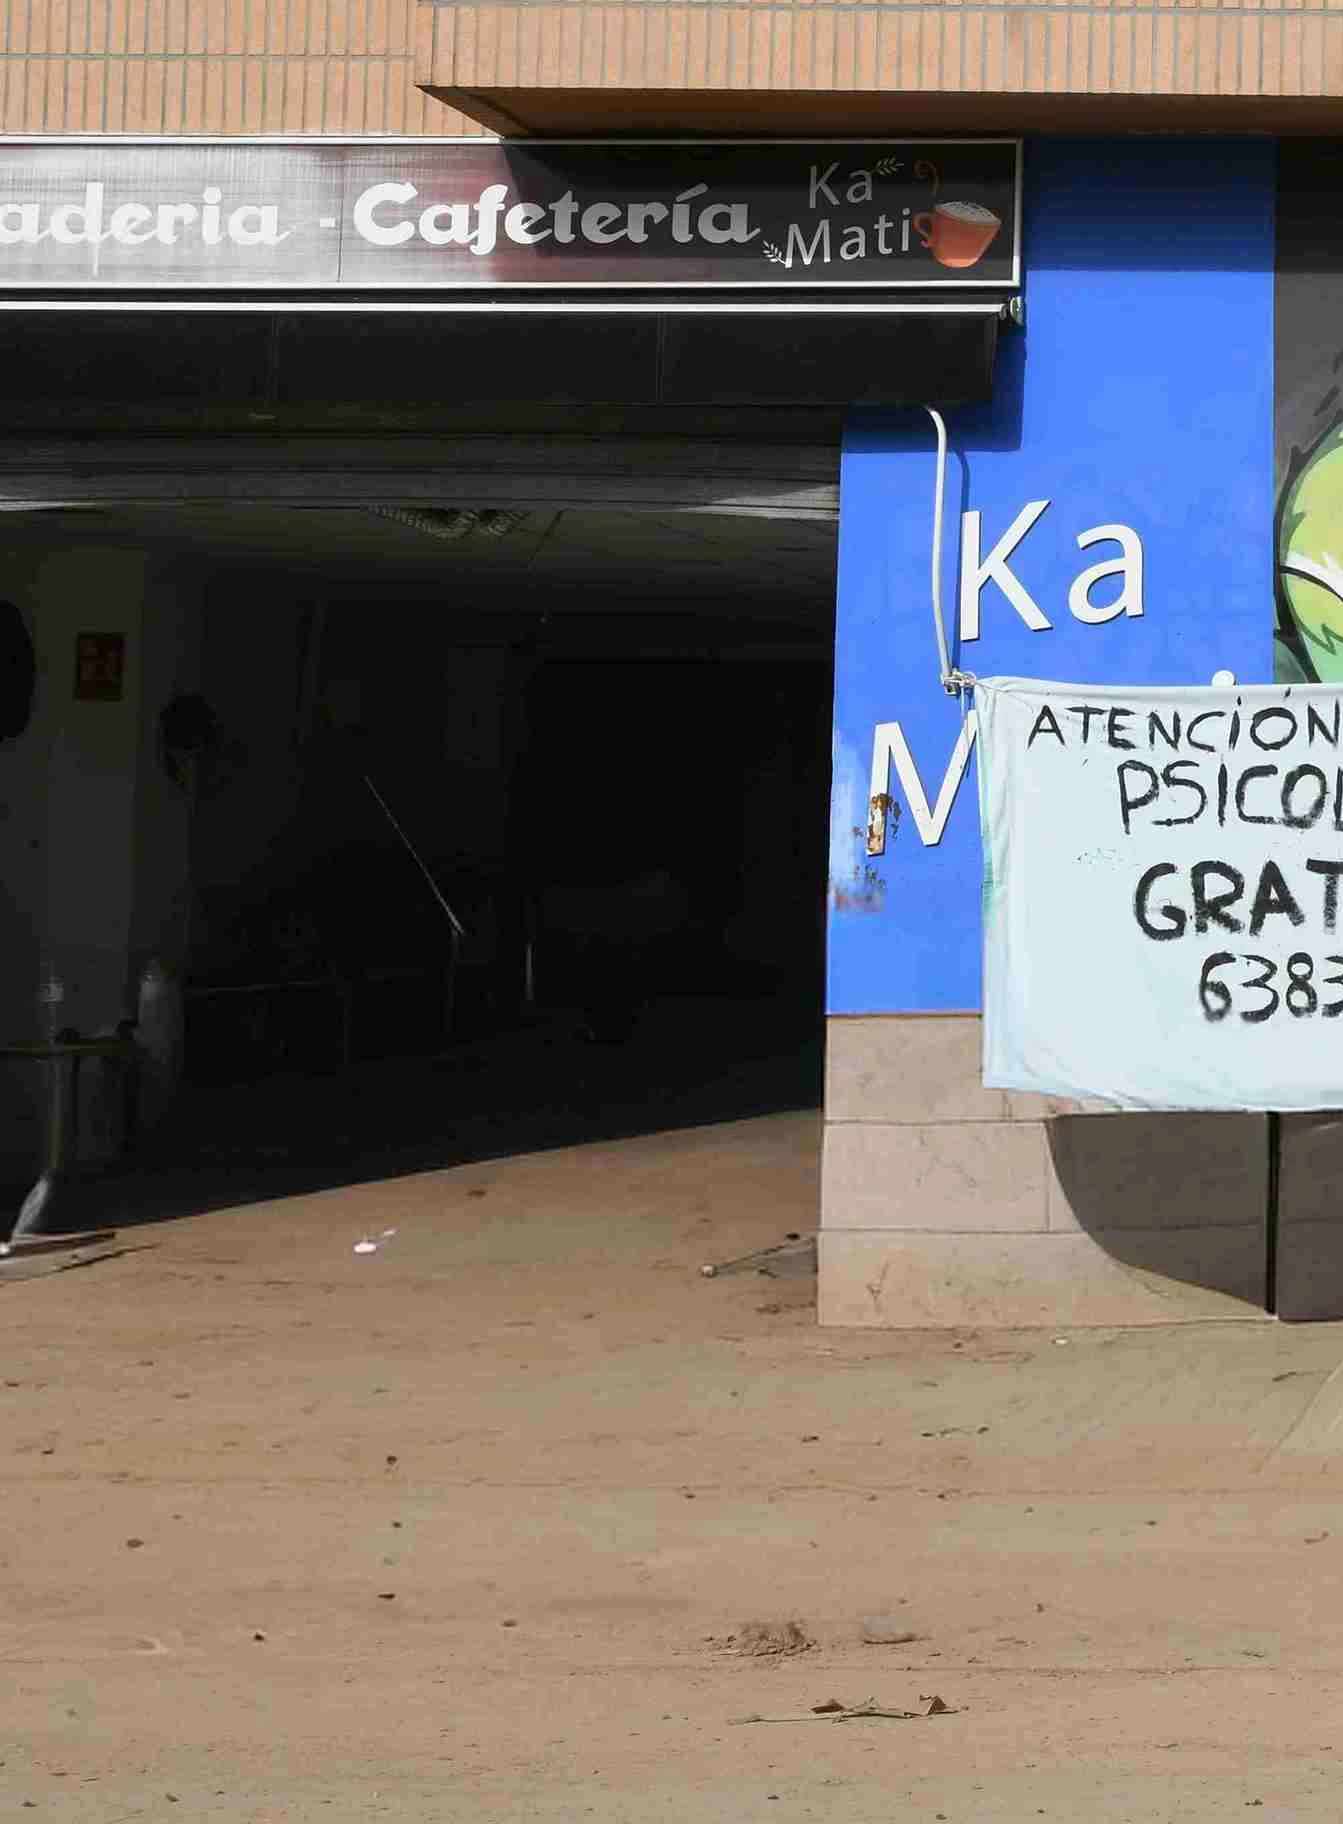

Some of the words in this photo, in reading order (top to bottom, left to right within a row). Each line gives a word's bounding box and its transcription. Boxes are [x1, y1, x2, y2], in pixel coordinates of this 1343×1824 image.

[808, 160, 873, 209] Ka
[353, 182, 761, 255] Cafetería
[785, 208, 911, 268] Mati
[960, 499, 1145, 641] Ka
